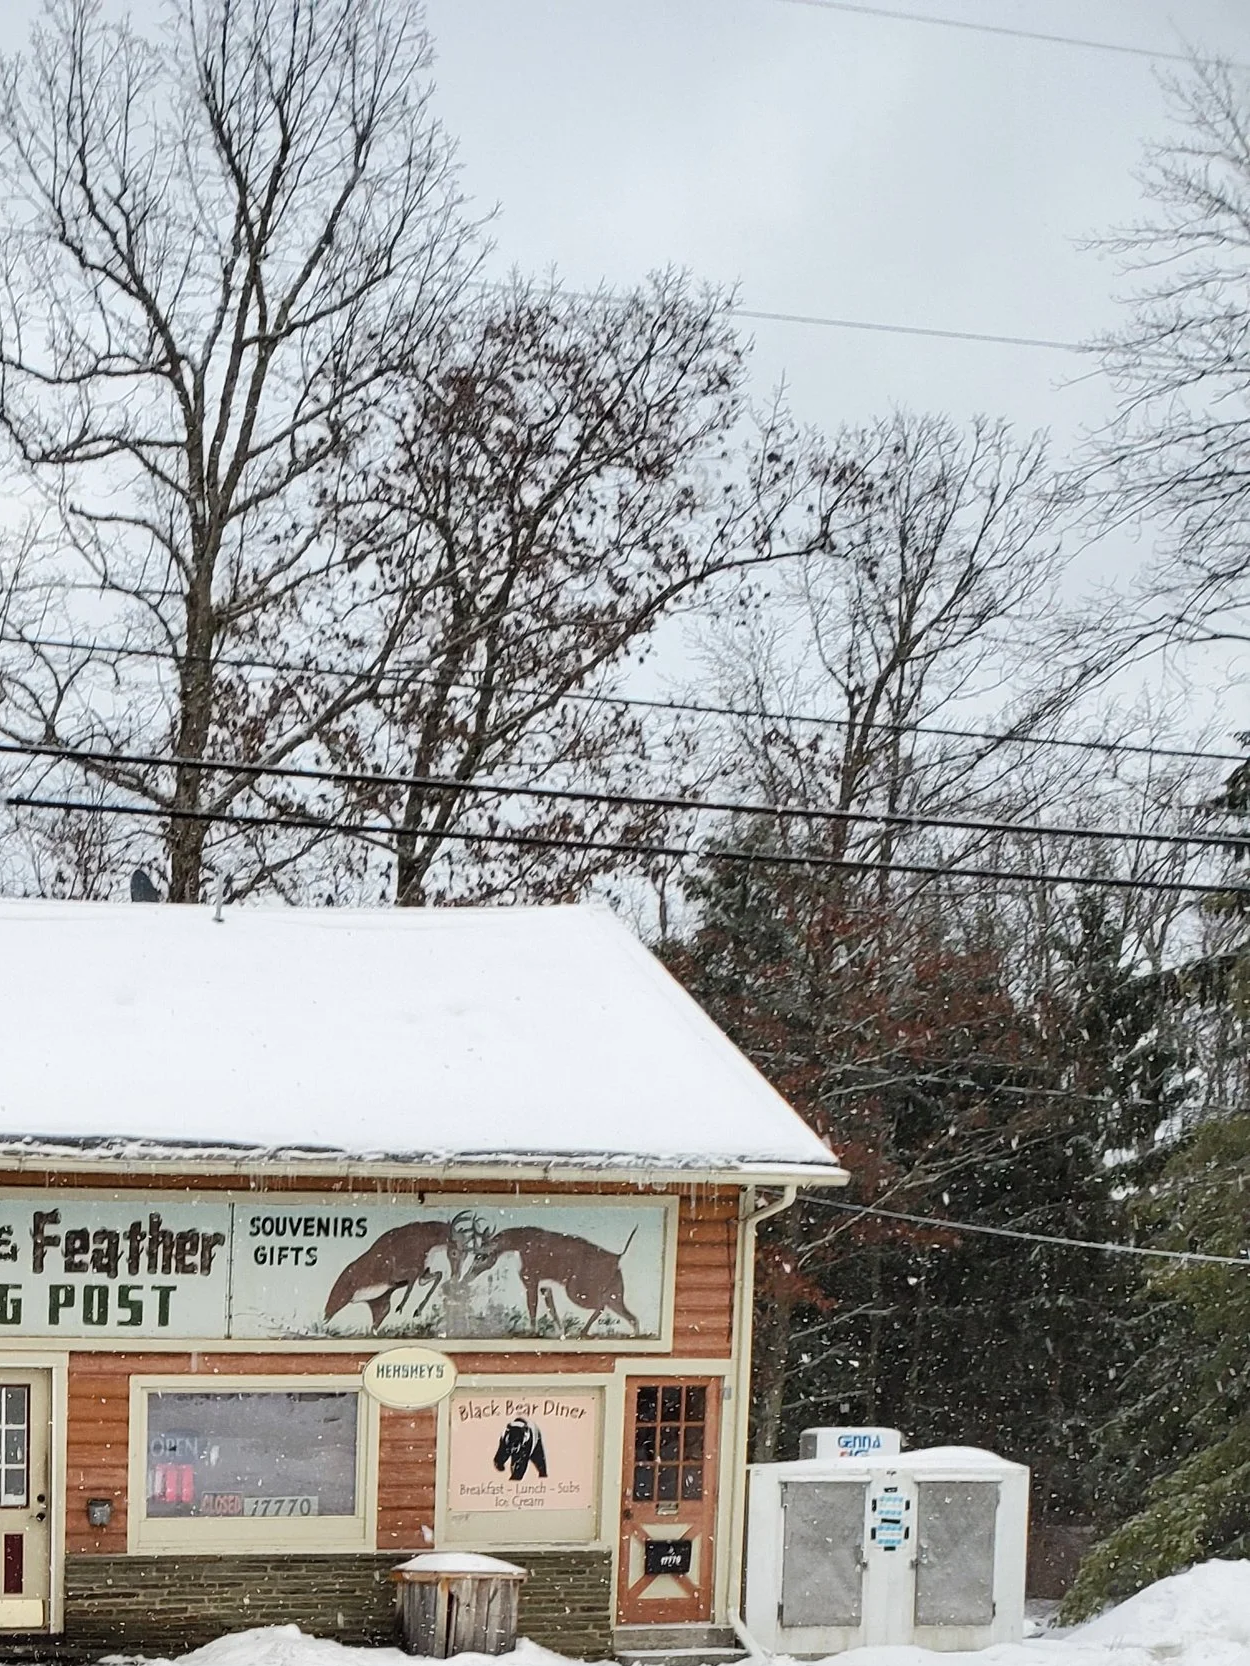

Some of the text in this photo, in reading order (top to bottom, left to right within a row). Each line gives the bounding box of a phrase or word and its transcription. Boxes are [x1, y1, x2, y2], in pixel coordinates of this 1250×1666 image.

[249, 1215, 369, 1238] SOUVENIRS
[29, 1207, 226, 1279] Feather
[253, 1245, 319, 1267] GIFTS
[48, 1284, 178, 1327] POST
[458, 1399, 587, 1421] Black Bear Diner
[150, 1437, 198, 1457] OPEN
[459, 1481, 504, 1495] Breakfast
[516, 1481, 547, 1495] Lunch
[557, 1480, 581, 1494] Subs
[202, 1493, 242, 1516] CLOSED
[251, 1498, 312, 1516] 17770
[511, 1495, 545, 1508] Cream
